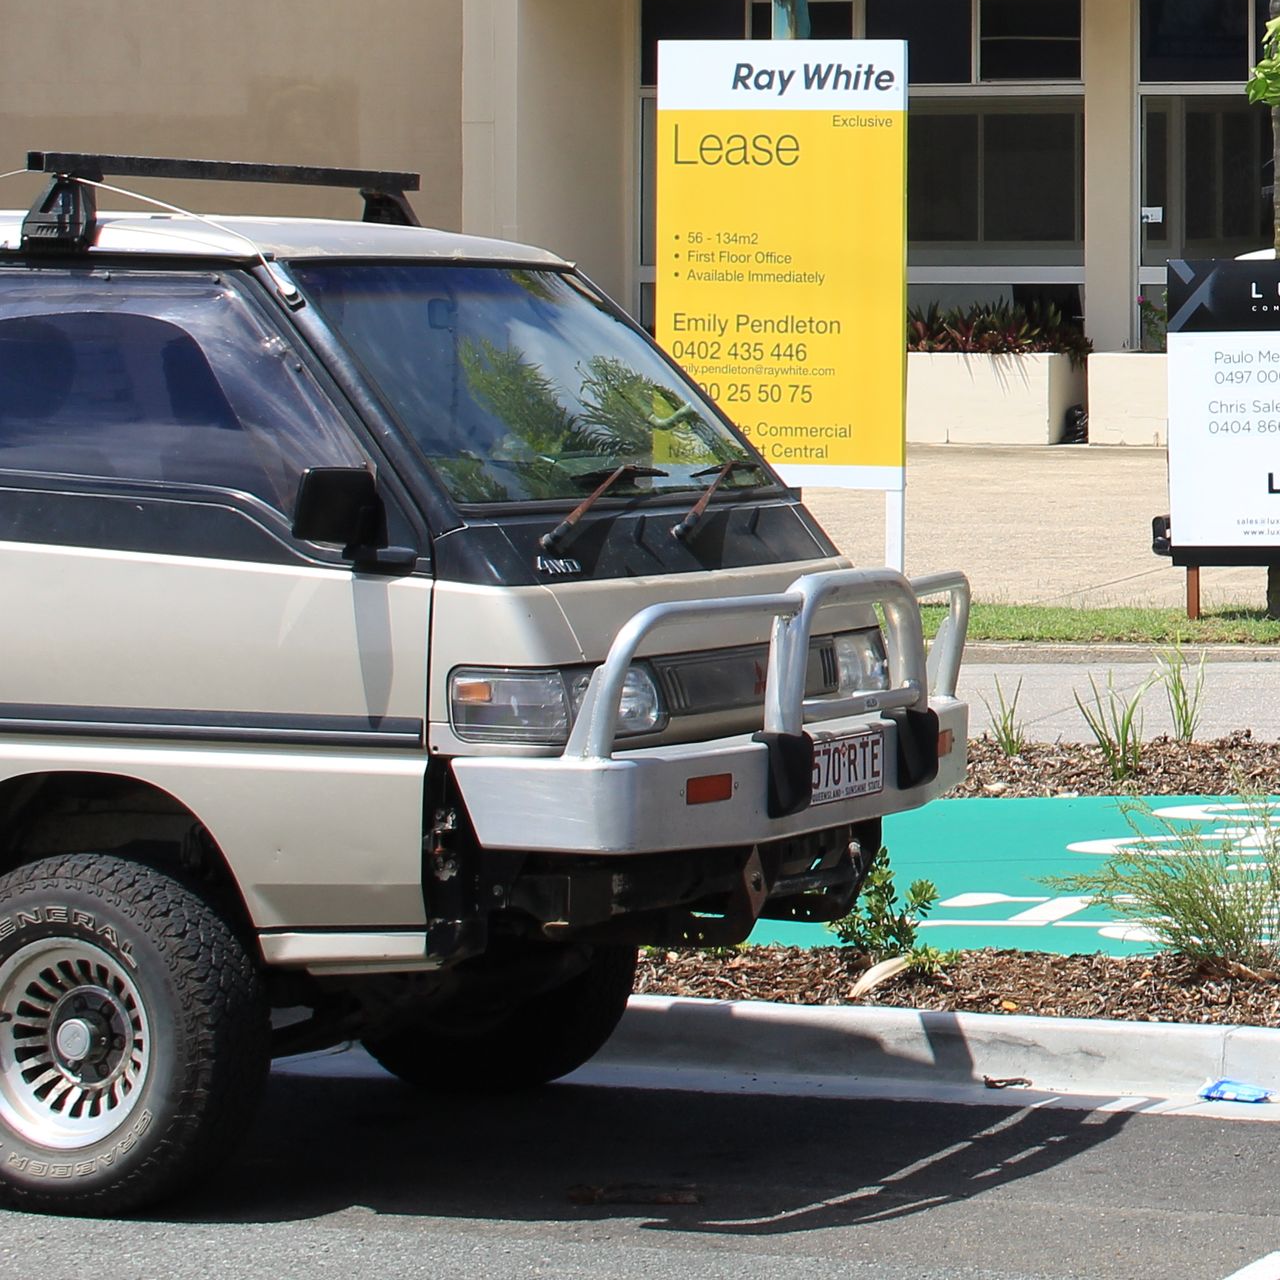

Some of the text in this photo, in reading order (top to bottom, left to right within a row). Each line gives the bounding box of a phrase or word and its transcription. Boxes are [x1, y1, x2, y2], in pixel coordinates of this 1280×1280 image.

[731, 63, 895, 96] Ray White
[832, 115, 893, 127] Exclusive
[674, 124, 800, 165] Lease
[687, 232, 703, 244] 56
[715, 232, 759, 245] 134m2
[688, 251, 792, 264] First Floor Office
[687, 269, 825, 285] Available Immediately
[673, 313, 841, 336] Emily Pendleton
[672, 341, 807, 361] 0402 435 446
[1214, 350, 1254, 364] Paulo
[683, 364, 836, 377] ily.pendleton@raywhite.com
[1214, 370, 1252, 385] 0497
[727, 383, 751, 402] 25
[757, 384, 782, 403] 50
[788, 384, 812, 403] 75
[1208, 400, 1247, 414] Chris
[756, 422, 852, 438] Commercial
[1208, 420, 1251, 434] 0404
[771, 443, 829, 458] Central
[848, 739, 881, 785] RTE
